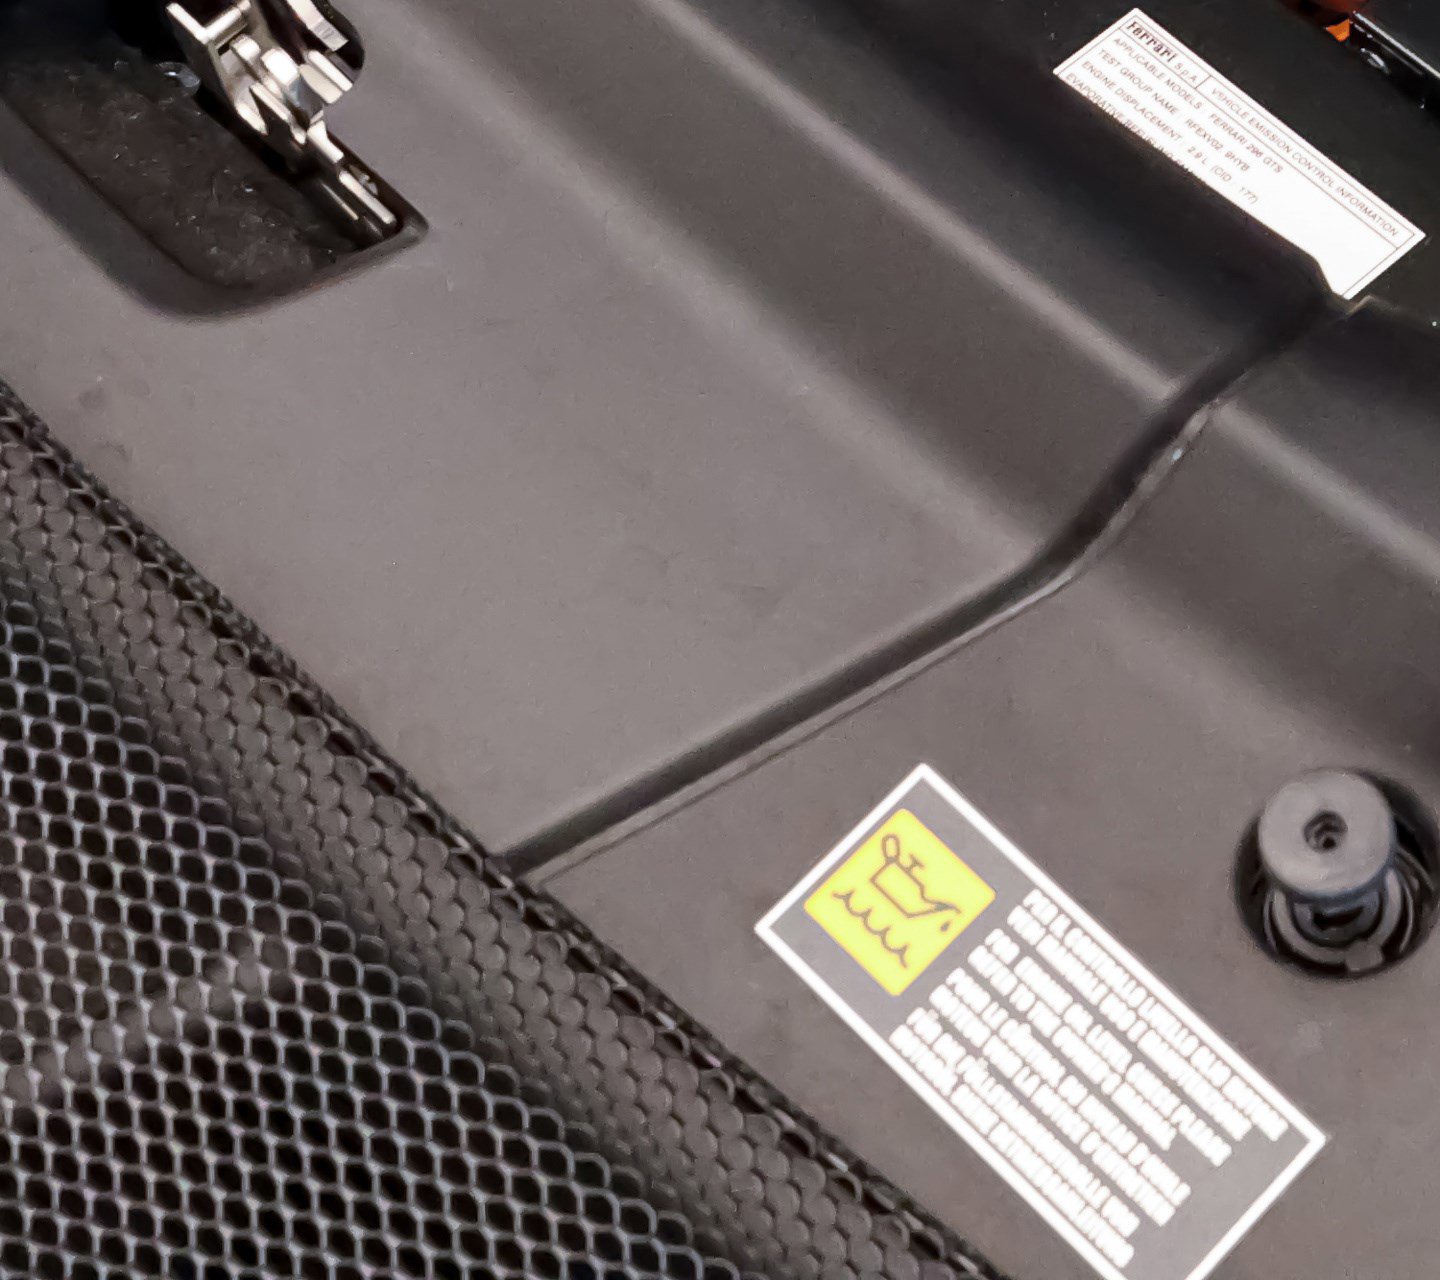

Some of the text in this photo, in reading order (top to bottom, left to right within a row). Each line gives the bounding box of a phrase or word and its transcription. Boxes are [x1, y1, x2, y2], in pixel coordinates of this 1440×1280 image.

[1094, 47, 1122, 69] TEST
[1116, 65, 1154, 95] GROUP
[1149, 91, 1180, 116] NAME
[1124, 19, 1179, 63] Ferrari
[1079, 59, 1118, 89] ENGINE
[1111, 86, 1185, 143] DISPLACEMENT
[1109, 36, 1167, 81] APPLICABLE
[1161, 77, 1204, 110] MODELS
[1206, 112, 1249, 146] FERRARI
[1260, 155, 1284, 174] GTS
[1208, 86, 1400, 237] VEHICLE EMISSION CONTROL INFORMATION
